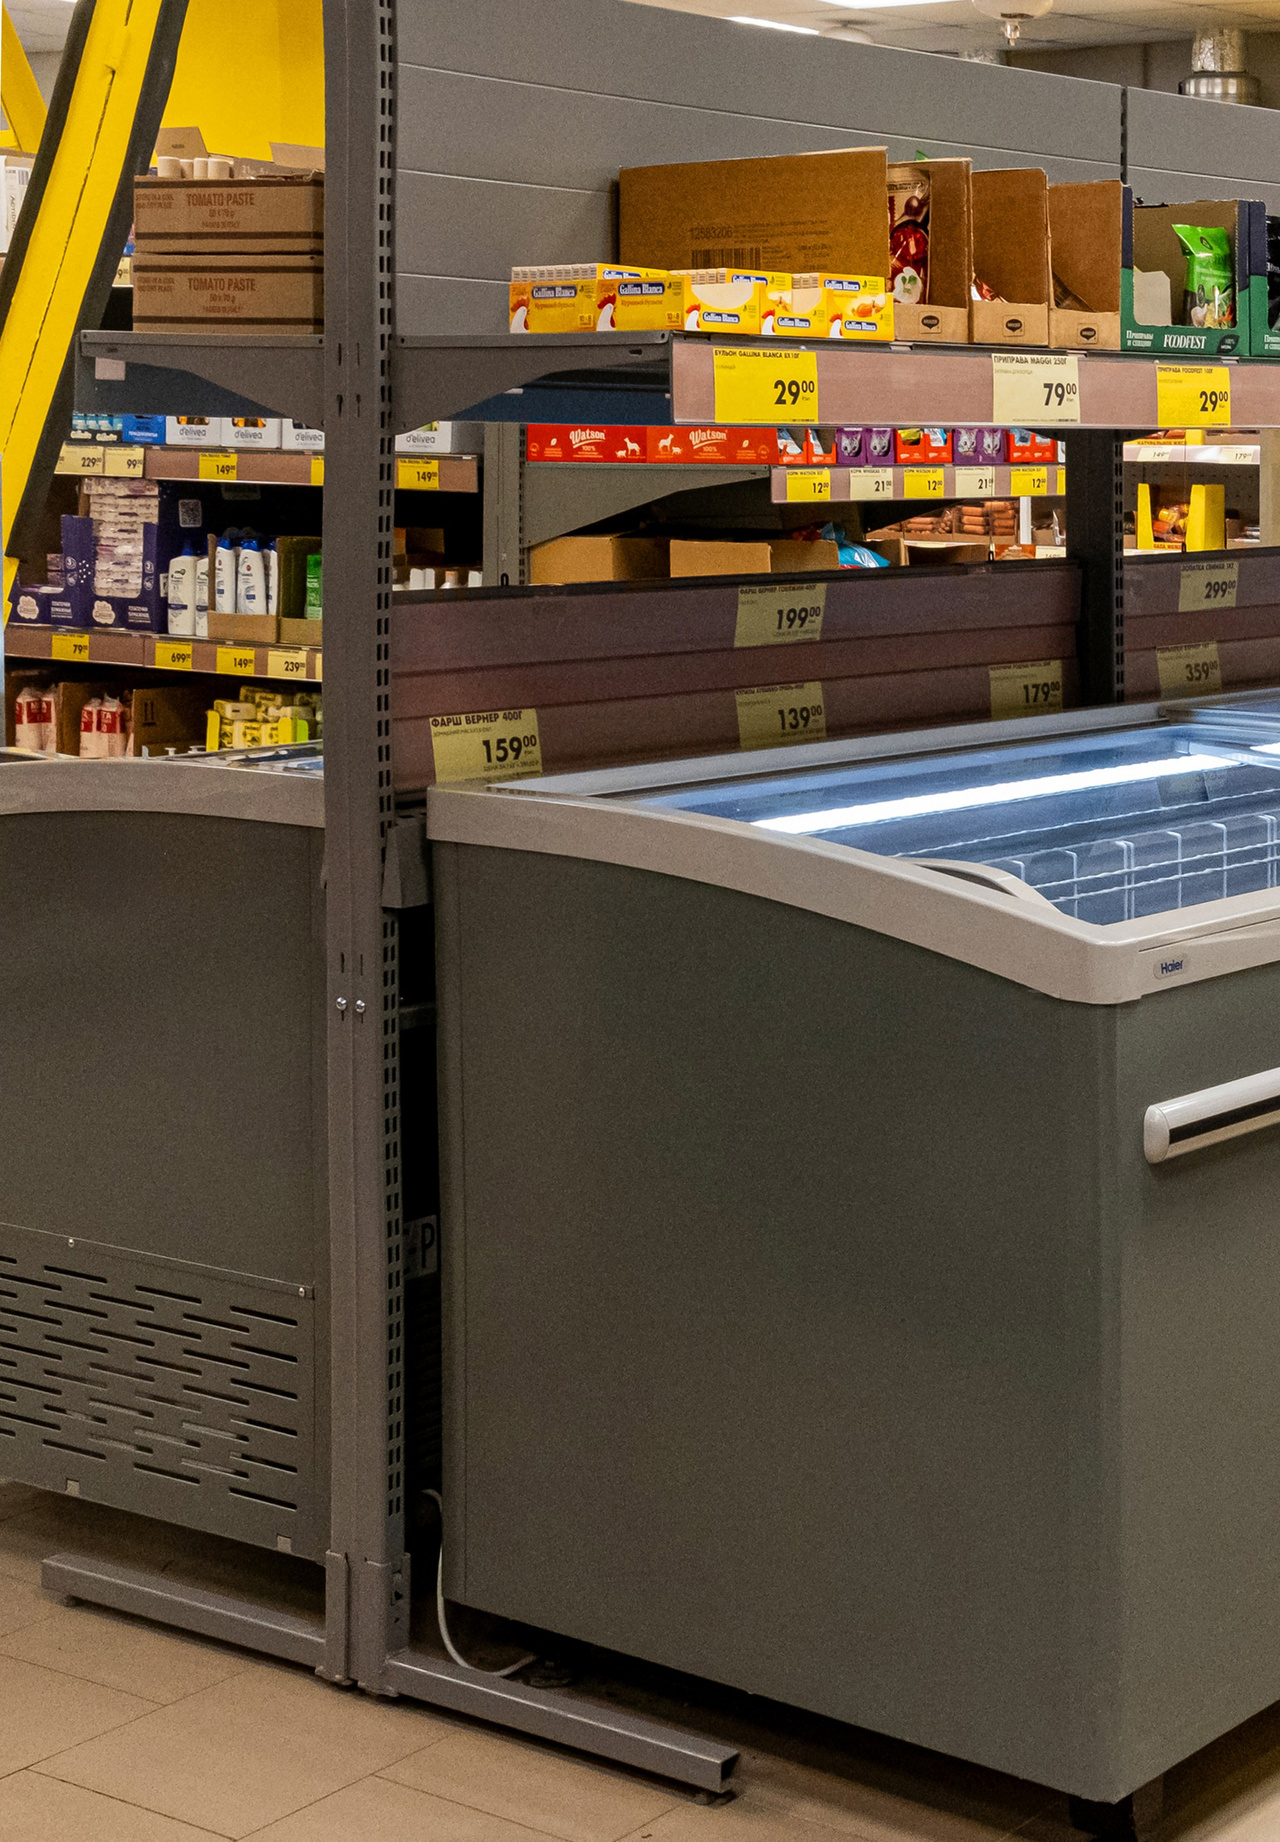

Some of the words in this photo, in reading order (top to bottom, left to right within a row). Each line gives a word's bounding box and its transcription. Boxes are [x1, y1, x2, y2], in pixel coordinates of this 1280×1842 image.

[186, 193, 225, 207] TOMATO
[226, 193, 256, 206] PASTE
[187, 277, 225, 291] TOMATO
[227, 278, 256, 291] PASTE
[620, 284, 641, 295] Gallina
[642, 283, 663, 294] Blanca
[533, 287, 554, 298] Gallina
[555, 287, 576, 298] Blanca
[1163, 334, 1207, 349] FOODFEST
[739, 350, 761, 358] GALLINA
[993, 355, 1028, 364] ПРИПРАВА
[1030, 357, 1052, 365] MAGGI
[569, 428, 605, 445] Watson
[689, 429, 727, 446] Watson
[431, 717, 462, 728] ФАРШ
[465, 712, 499, 725] ВЕРНЕР
[502, 710, 523, 721] 400Г
[1161, 960, 1183, 975] Haier
